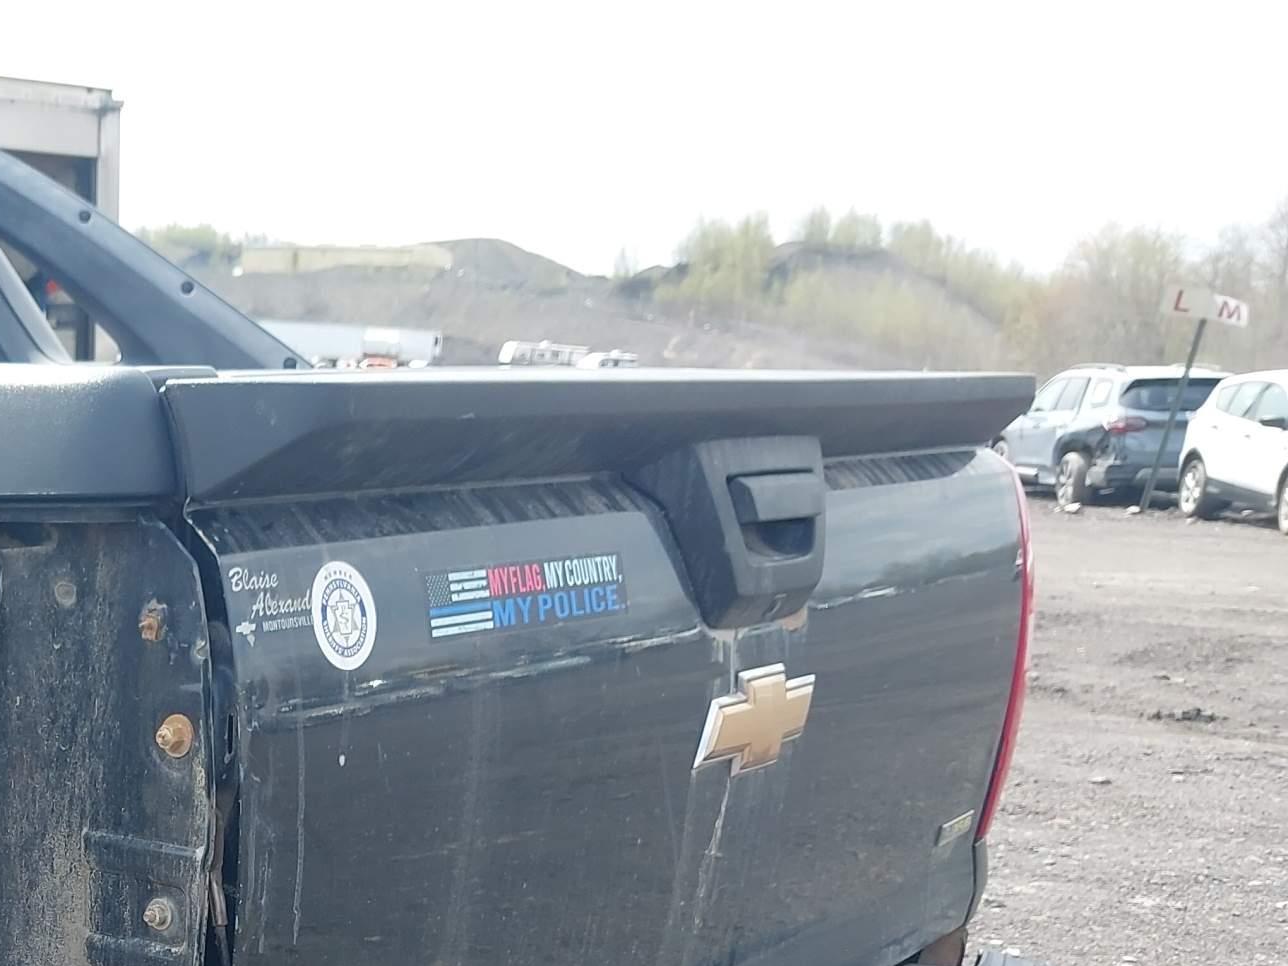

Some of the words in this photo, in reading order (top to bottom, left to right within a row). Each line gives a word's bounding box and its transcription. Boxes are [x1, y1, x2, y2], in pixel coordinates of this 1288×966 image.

[1173, 289, 1190, 313] L
[1217, 300, 1242, 322] M
[228, 567, 279, 592] Blaise
[487, 566, 512, 597] MY
[511, 562, 546, 595] FLAG,
[544, 560, 566, 590] MY
[564, 554, 623, 586] COUNTRY,
[493, 595, 533, 629] MY
